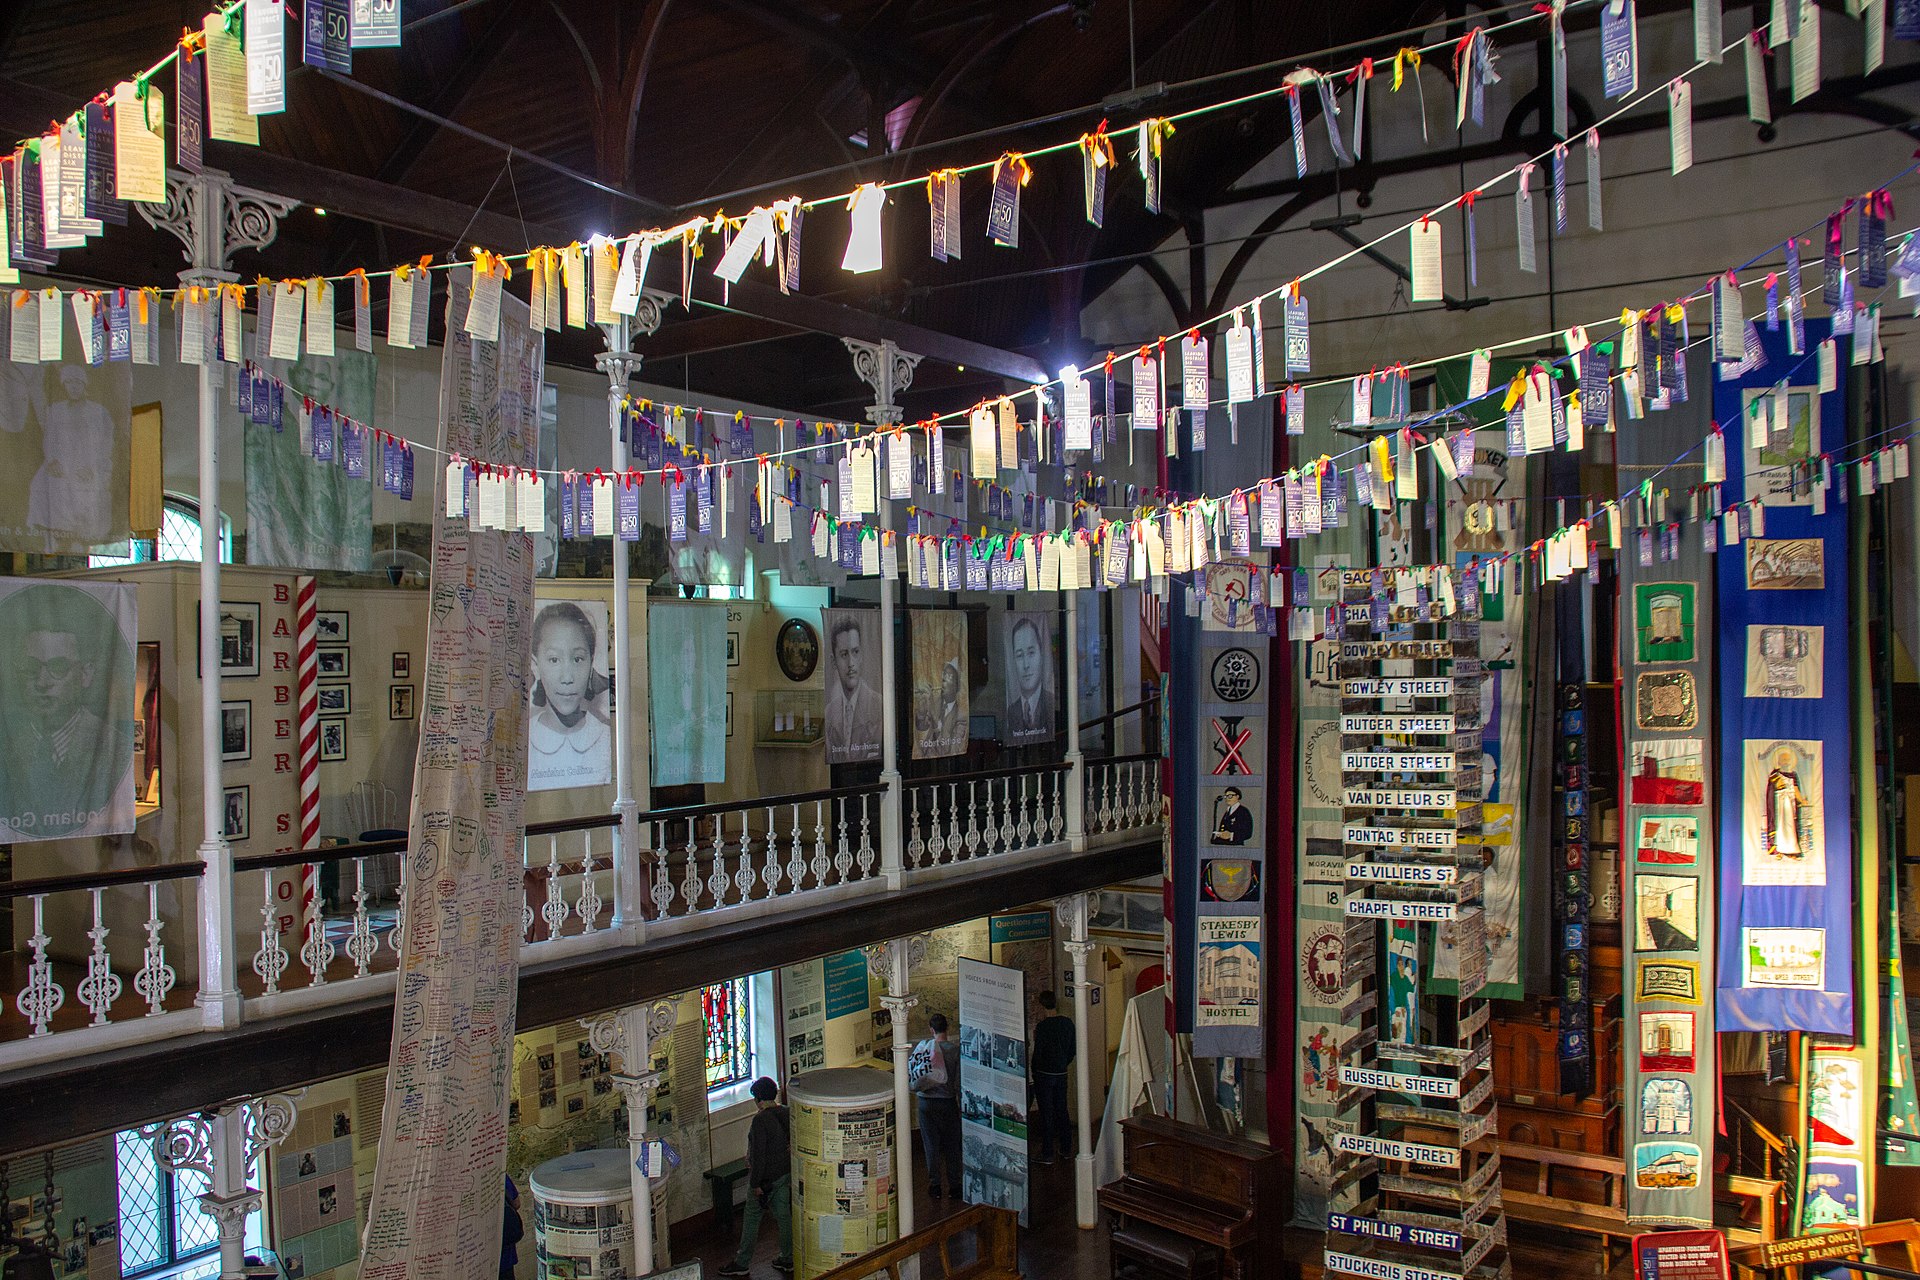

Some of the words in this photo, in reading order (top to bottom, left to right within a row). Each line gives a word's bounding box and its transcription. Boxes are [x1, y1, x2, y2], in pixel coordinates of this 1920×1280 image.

[327, 12, 348, 41] 50
[1616, 50, 1630, 71] 50
[265, 55, 281, 84] 50
[189, 122, 200, 146] 50
[105, 173, 115, 196] 5
[1000, 206, 1012, 223] 50
[118, 328, 129, 344] 50
[1297, 338, 1308, 355] 50
[1195, 378, 1206, 392] 50
[1144, 397, 1155, 412] 50
[1596, 390, 1607, 406] 50
[260, 403, 269, 416] 50
[324, 438, 333, 451] 50
[899, 470, 910, 483] 50
[1310, 505, 1319, 518] 50
[1328, 499, 1337, 512] 50
[628, 516, 637, 528] 50
[678, 515, 685, 528] 50
[1296, 510, 1304, 523] 50
[1270, 518, 1280, 531] 50
[1239, 529, 1248, 541] 50
[1116, 556, 1126, 569] 50
[727, 611, 742, 622] ers
[272, 582, 292, 774] BARBER
[1218, 676, 1251, 688] ANTI
[1345, 682, 1394, 695] COWLEY
[1400, 681, 1449, 694] STREET
[1346, 718, 1393, 731] RUTGER
[1399, 718, 1451, 731] STREET
[1347, 756, 1395, 769] RUTGER
[1400, 756, 1451, 769] STREET
[1348, 792, 1373, 805] VAN
[1375, 792, 1392, 805] DE
[1395, 793, 1433, 806] LEUR
[1348, 829, 1395, 843] PONTAC
[1400, 831, 1452, 844] STREET
[1308, 860, 1344, 869] MORAVIA
[1320, 869, 1342, 877] HILL
[1350, 865, 1367, 878] DE
[1371, 866, 1431, 880] VILLIERS
[1326, 890, 1339, 905] 18
[1402, 904, 1452, 918] STREET
[995, 919, 1030, 929] Questions
[1200, 920, 1259, 931] STAKESBY
[1210, 930, 1247, 940] LEWIS
[1301, 936, 1315, 967] VICIT
[1312, 924, 1341, 941] AGNUS
[965, 973, 982, 983] VOICES
[982, 977, 996, 986] FROM
[1206, 1008, 1251, 1017] HOSTEL
[1344, 1071, 1399, 1088] RUSSELL
[1405, 1078, 1453, 1094] STREET
[1340, 1136, 1401, 1159] ASPELING
[1404, 1147, 1455, 1164] STREET
[1330, 1215, 1348, 1229] ST
[1352, 1218, 1403, 1241] PHILLIP
[1409, 1229, 1459, 1249] STREET
[1767, 1235, 1826, 1254] EUROPEANS
[1827, 1231, 1857, 1244] ONLY.
[1464, 1233, 1492, 1271] ELLESMERE
[1770, 1252, 1805, 1266] SLEGS
[1328, 1255, 1401, 1279] STUCKERIS
